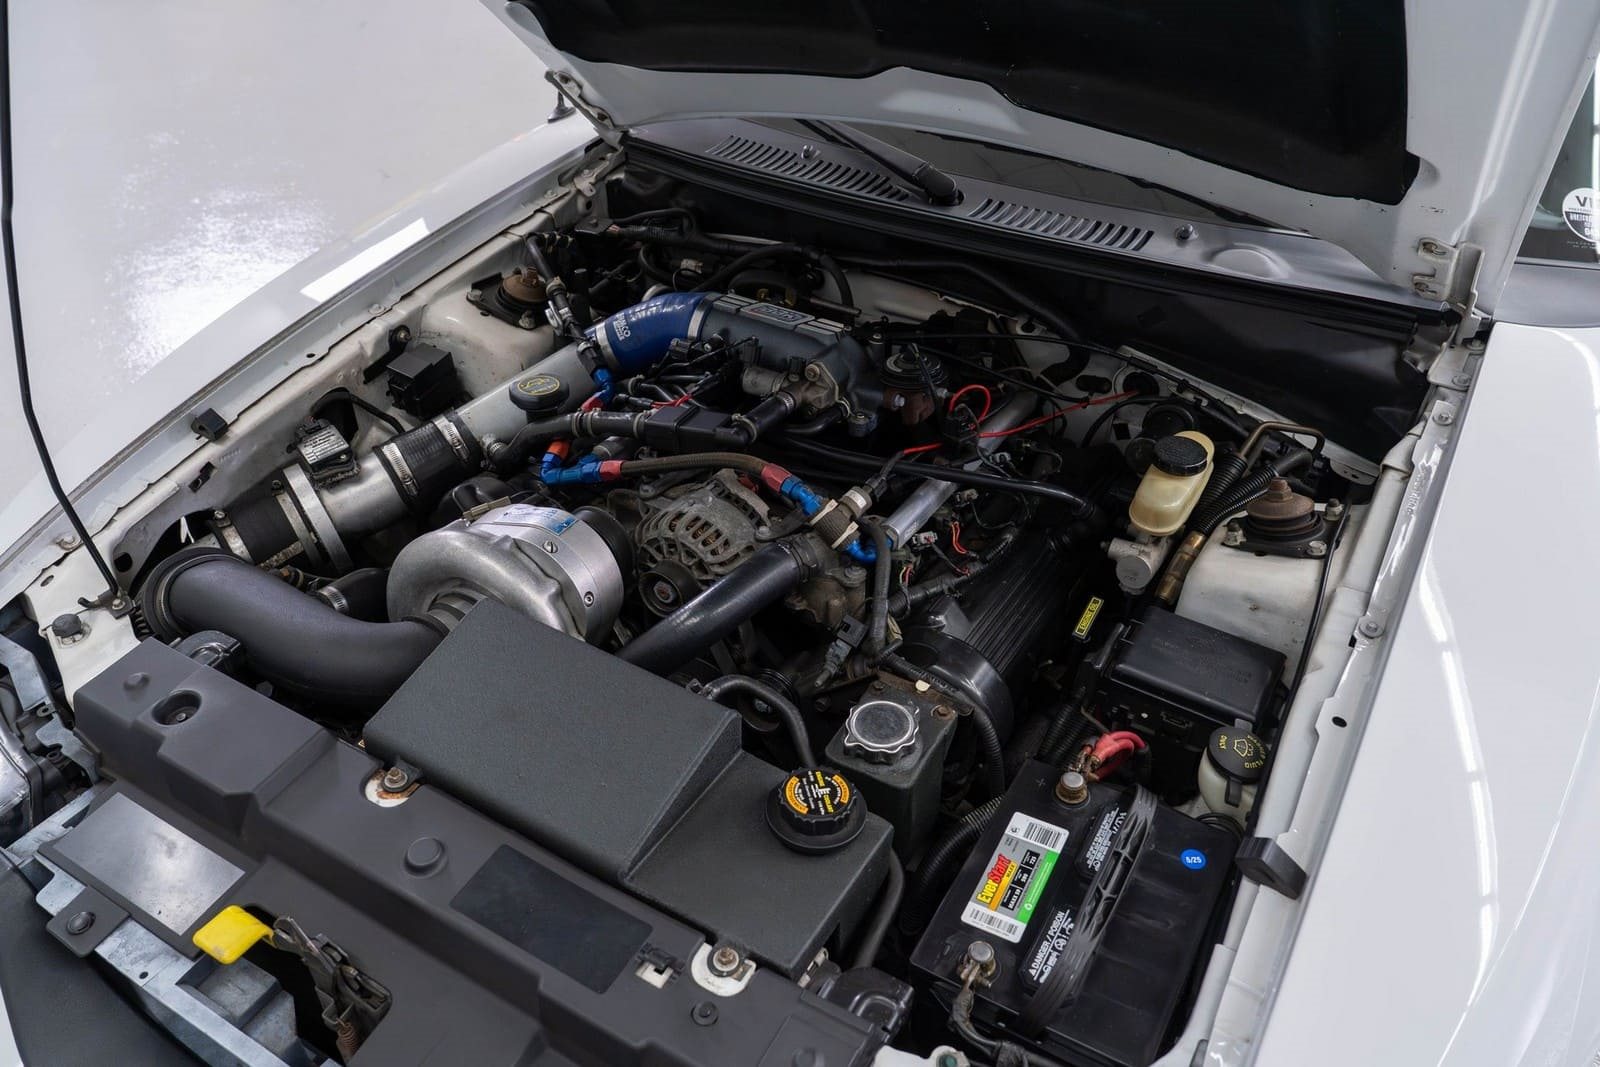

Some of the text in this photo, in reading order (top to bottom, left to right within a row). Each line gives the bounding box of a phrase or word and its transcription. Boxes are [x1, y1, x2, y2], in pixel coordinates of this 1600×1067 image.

[976, 853, 1011, 904] EverStart
[1031, 941, 1051, 969] DANGER
[1047, 910, 1066, 936] POISON
